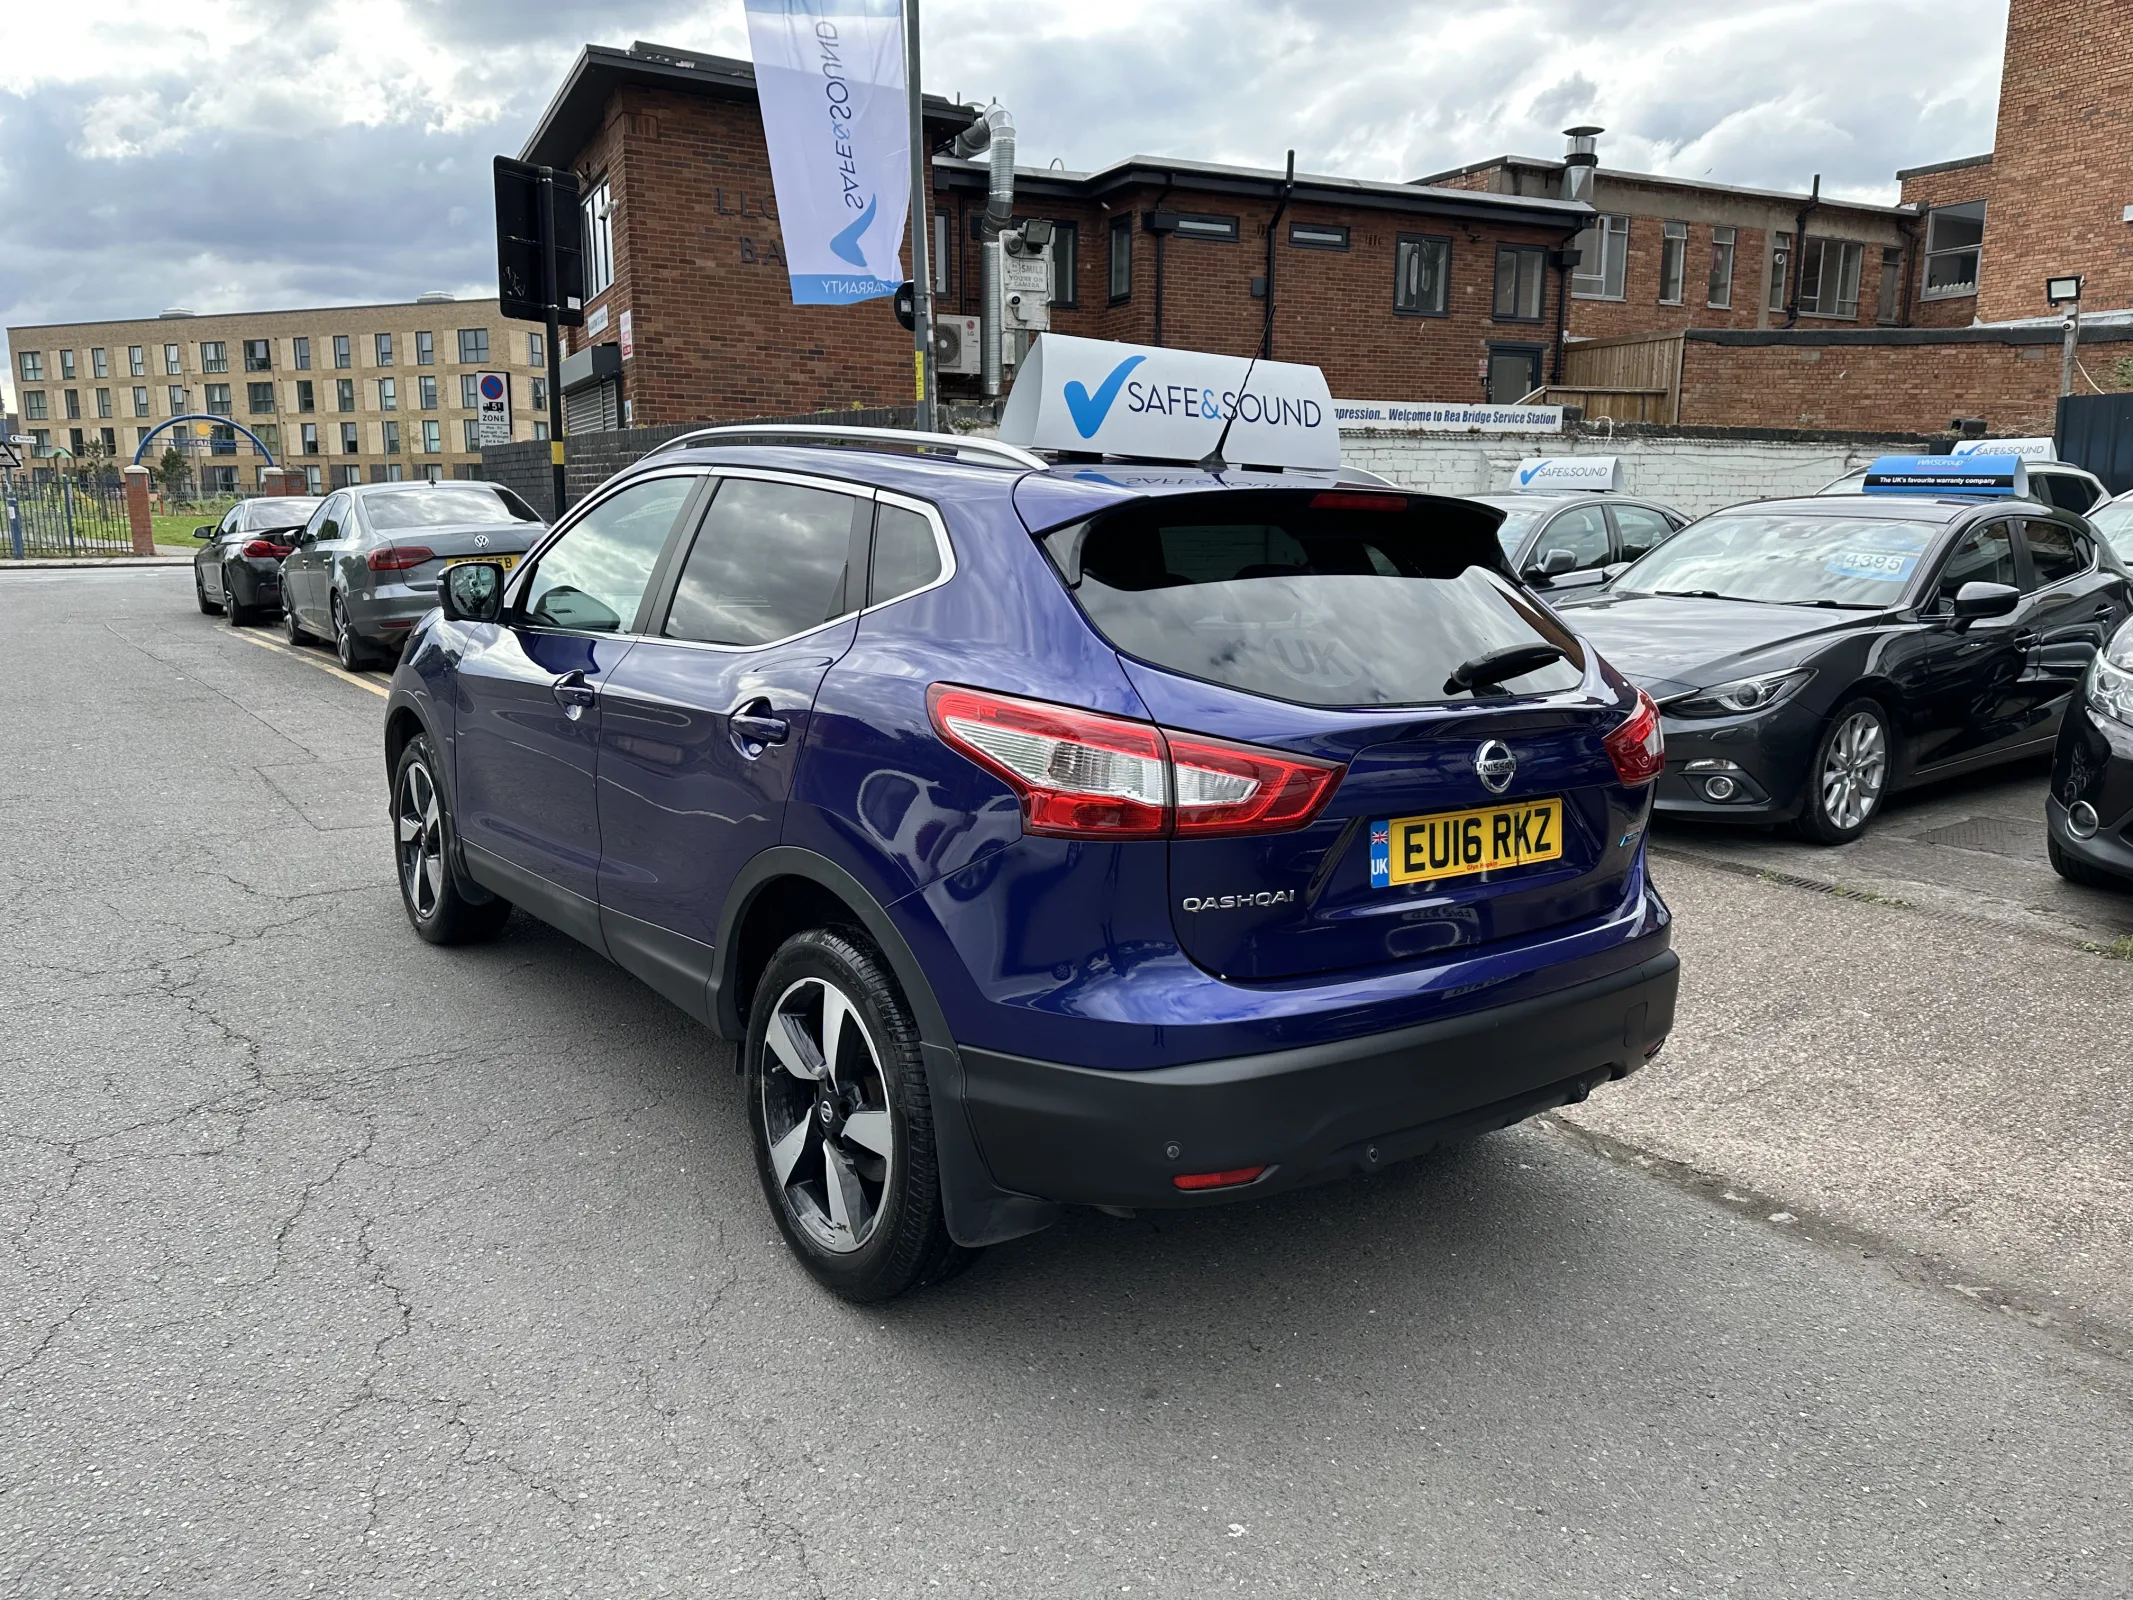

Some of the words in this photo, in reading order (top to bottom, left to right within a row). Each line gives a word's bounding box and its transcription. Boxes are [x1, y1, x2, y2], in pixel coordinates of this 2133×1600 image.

[1021, 264, 1044, 274] SMILE
[1014, 281, 1040, 289] CAMERA
[1127, 381, 1322, 428] SAFE&SOUND
[482, 414, 505, 422] ZONE
[1388, 408, 1430, 422] Welcome
[1433, 410, 1443, 422] to
[1444, 409, 1460, 423] Rea
[1462, 410, 1491, 425] Bridge
[1493, 411, 1526, 424] Service
[1526, 412, 1557, 425] Station
[1976, 445, 2045, 456] SAFE&SOUND
[1539, 467, 1608, 477] SAFE&SOUND
[1879, 476, 1889, 484] The
[1891, 476, 1907, 484] UK's
[1907, 476, 1936, 484] favourite
[1936, 477, 1964, 486] warranty
[1964, 478, 1997, 486] company
[1845, 555, 1904, 571] 4395
[1273, 638, 1356, 677] UK
[1483, 761, 1515, 772] NISSAN
[1404, 817, 1483, 874] EU16
[1493, 807, 1552, 860] RKZ
[1371, 857, 1389, 876] UK
[1466, 863, 1480, 871] Glyn
[1182, 889, 1296, 913] QASHQAI
